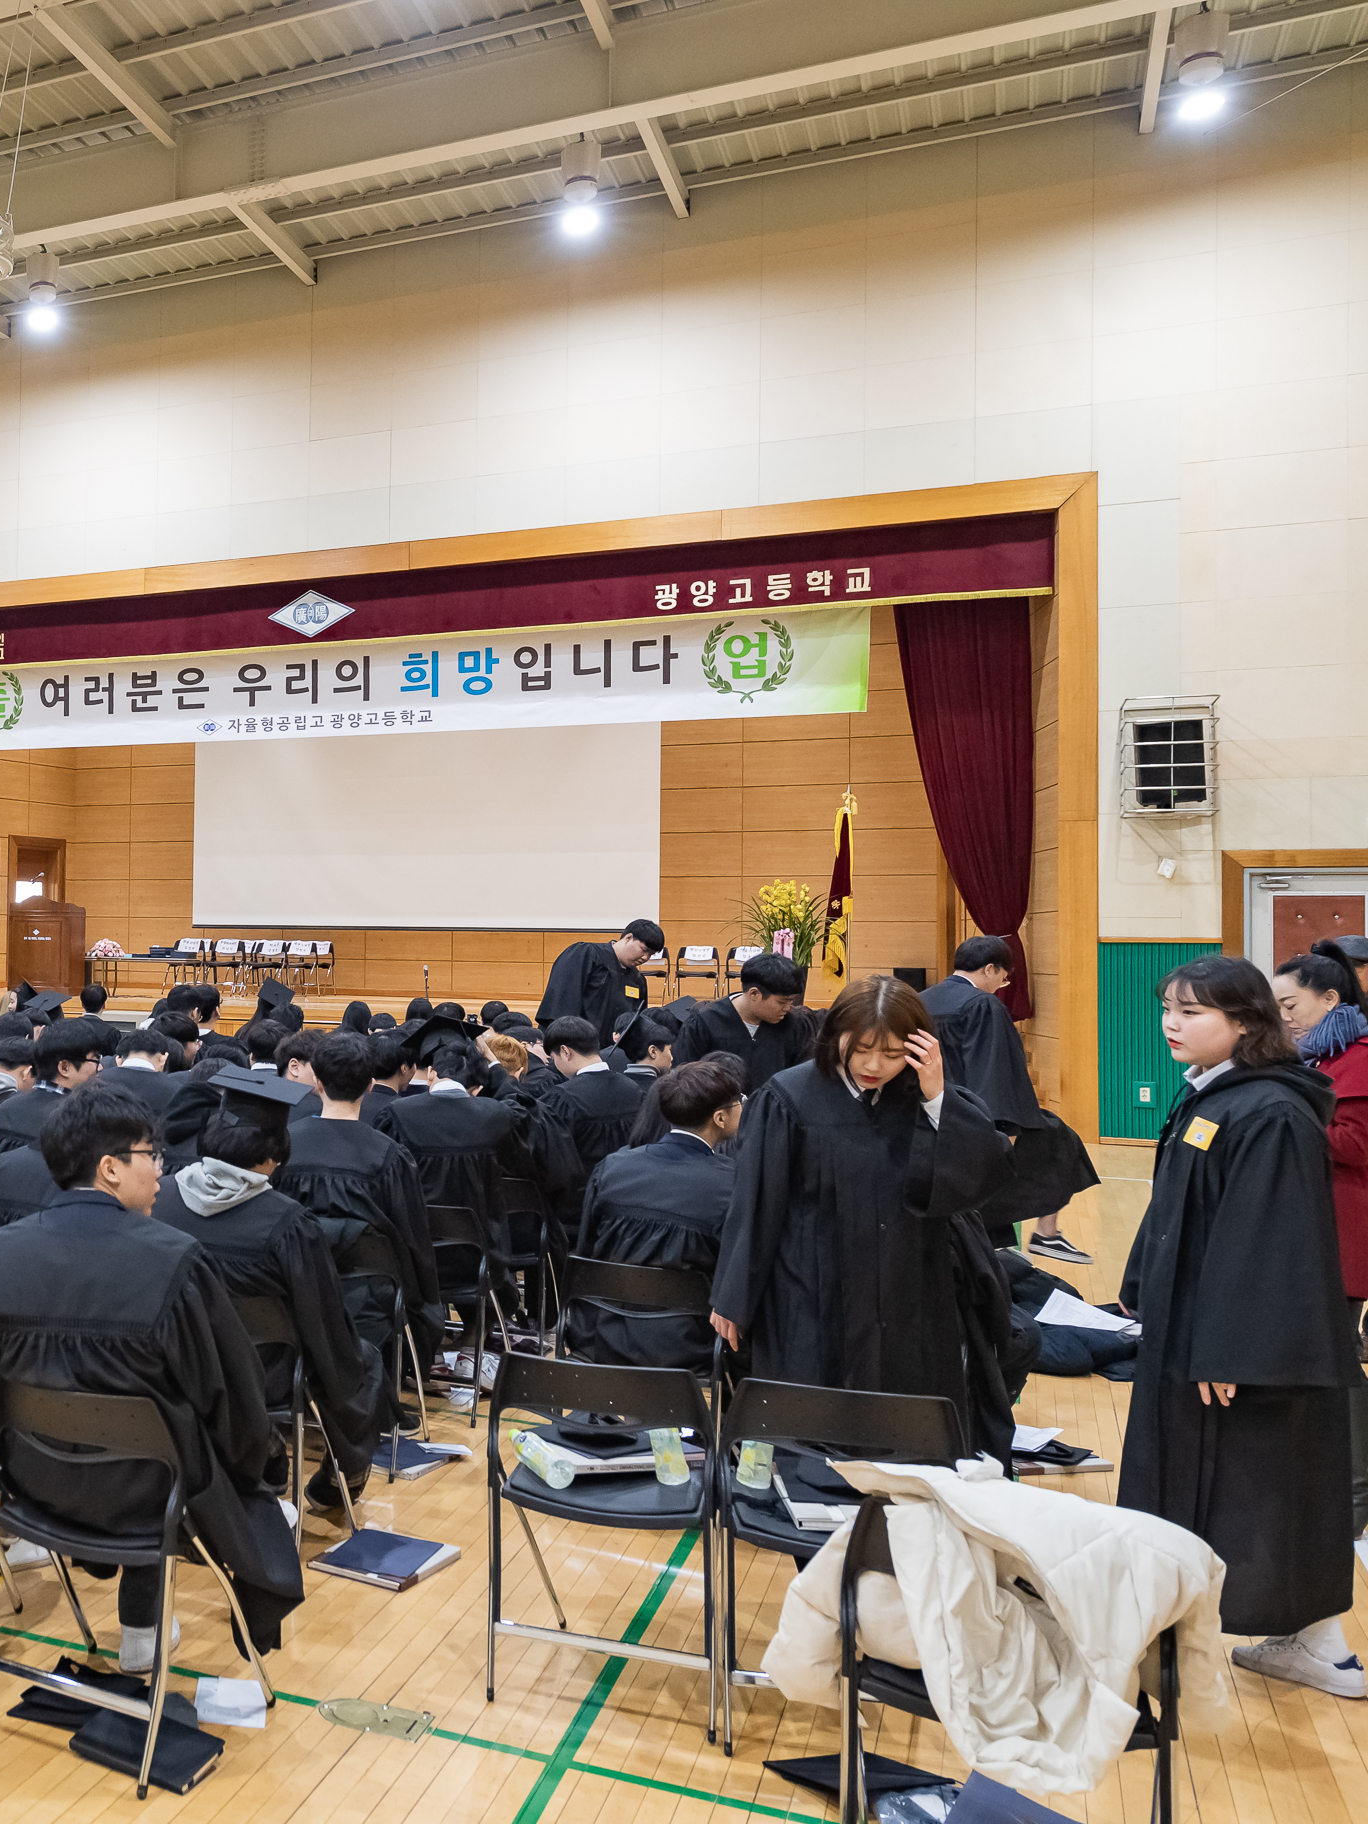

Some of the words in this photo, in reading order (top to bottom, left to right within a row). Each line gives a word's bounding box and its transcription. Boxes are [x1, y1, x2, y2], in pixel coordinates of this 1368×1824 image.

[654, 567, 871, 610] 광양고등학교
[40, 667, 209, 716] 여러분은
[233, 655, 370, 707] 우리의
[400, 635, 679, 698] 희망입니다
[723, 632, 768, 680] 업
[227, 715, 325, 733] 자율형공립고
[330, 709, 433, 729] 광양고등학교
